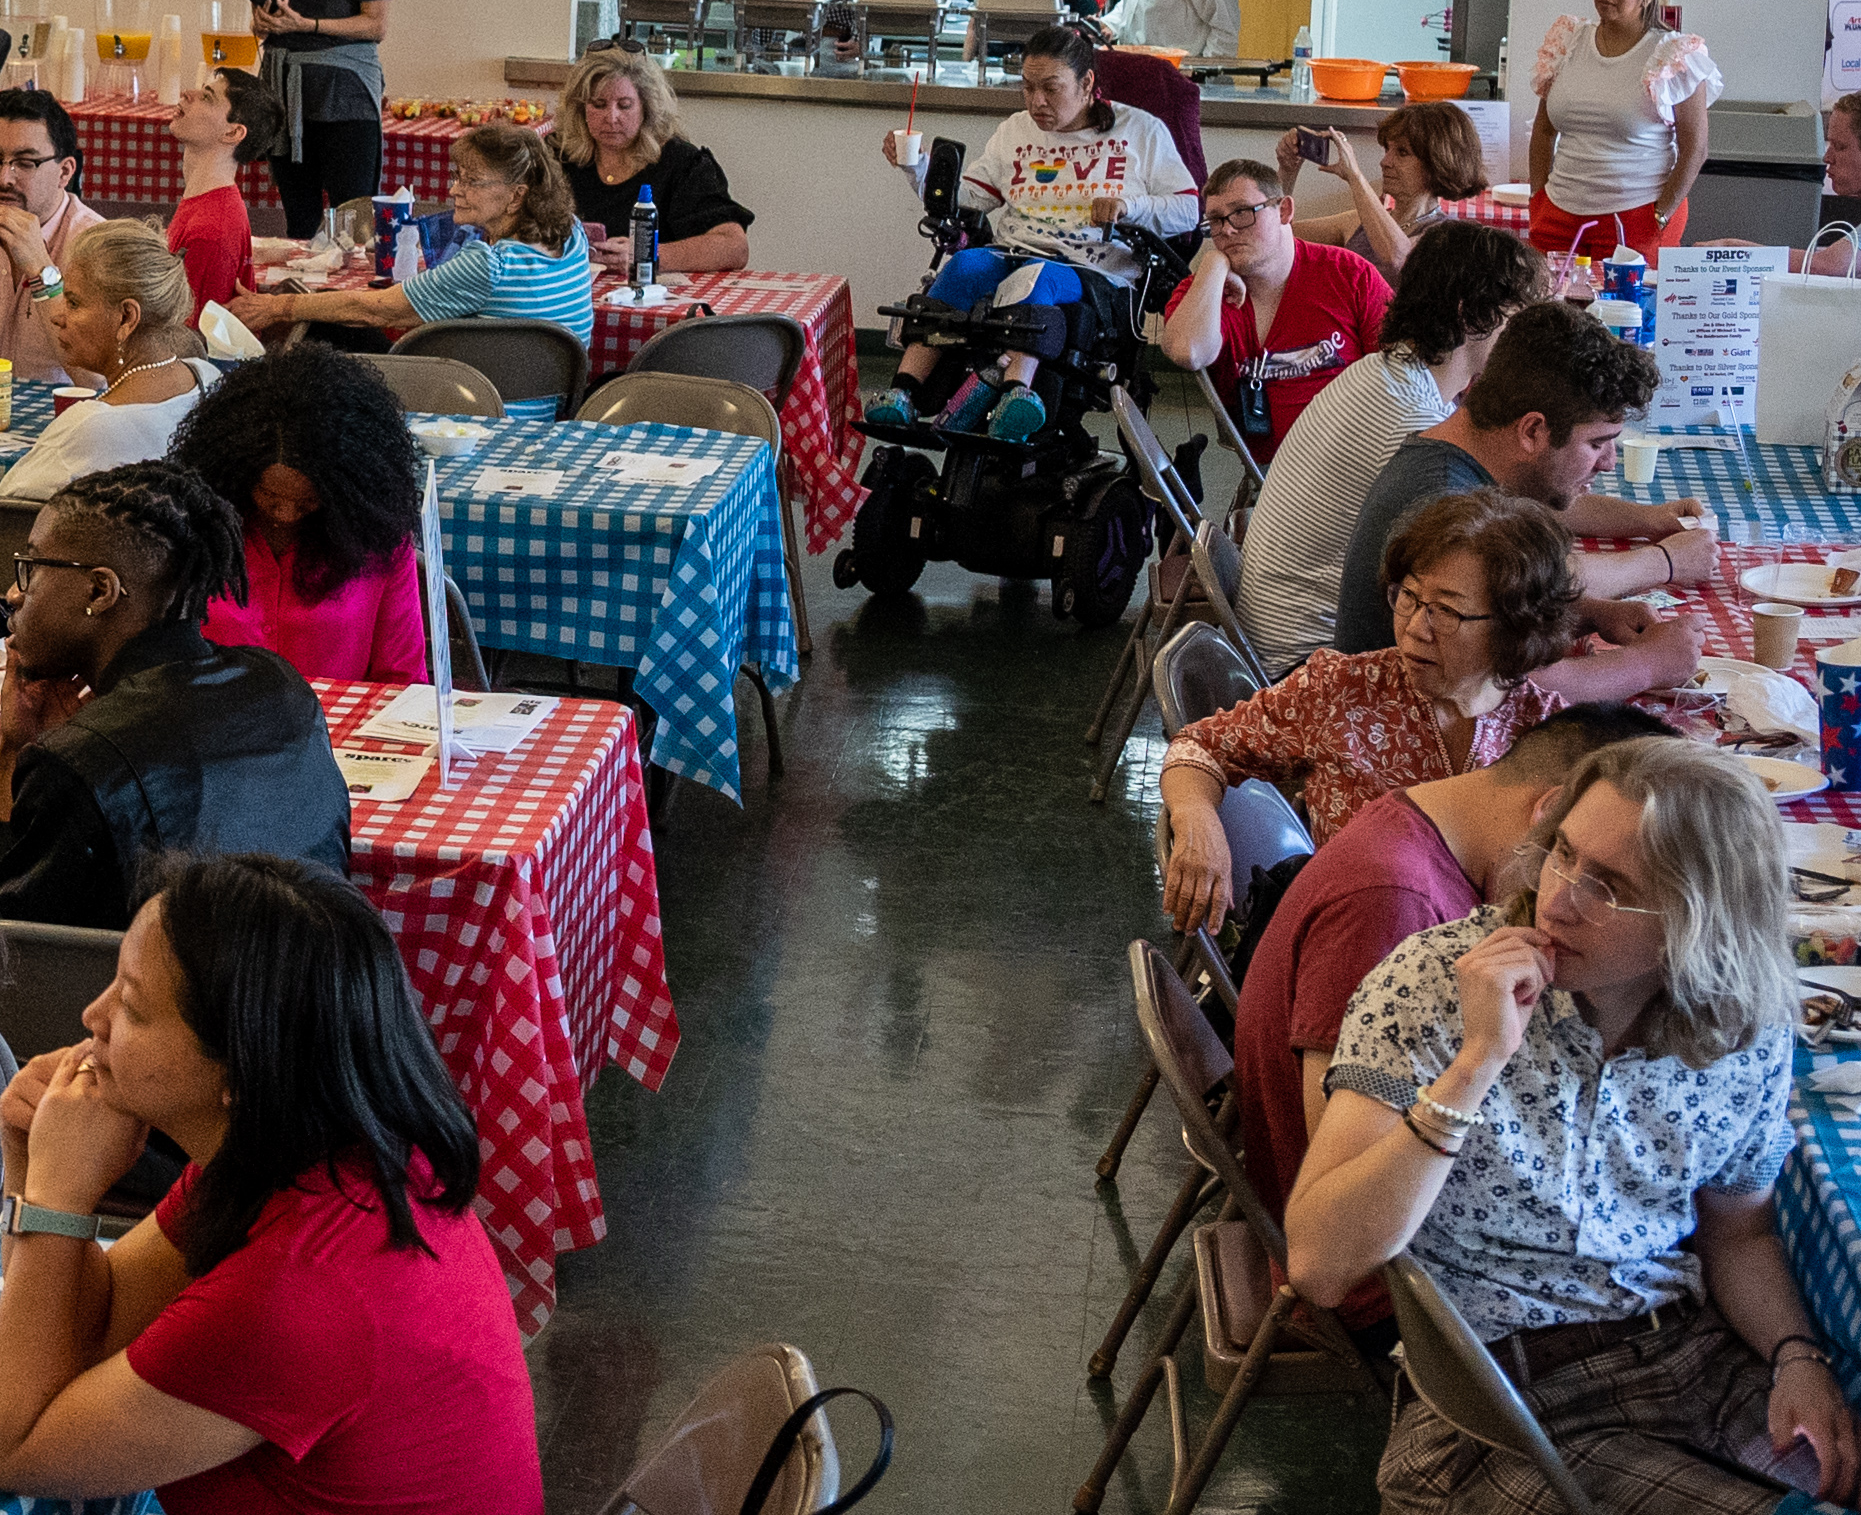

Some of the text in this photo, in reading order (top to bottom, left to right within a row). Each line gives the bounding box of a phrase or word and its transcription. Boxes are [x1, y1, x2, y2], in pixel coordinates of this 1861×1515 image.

[1841, 58, 1860, 69] Local
[1706, 250, 1745, 262] sparc
[1674, 265, 1699, 273] Thanks
[1722, 265, 1741, 273] Event
[1742, 265, 1774, 274] Sponsors!
[1671, 312, 1697, 320] Thanks
[1721, 311, 1737, 319] Gold
[1739, 311, 1759, 320] Spons
[1319, 330, 1346, 360] DC
[1730, 348, 1751, 357] Giant
[1669, 364, 1694, 372] Thanks
[1737, 364, 1758, 372] Spons
[345, 751, 402, 764] sparc
